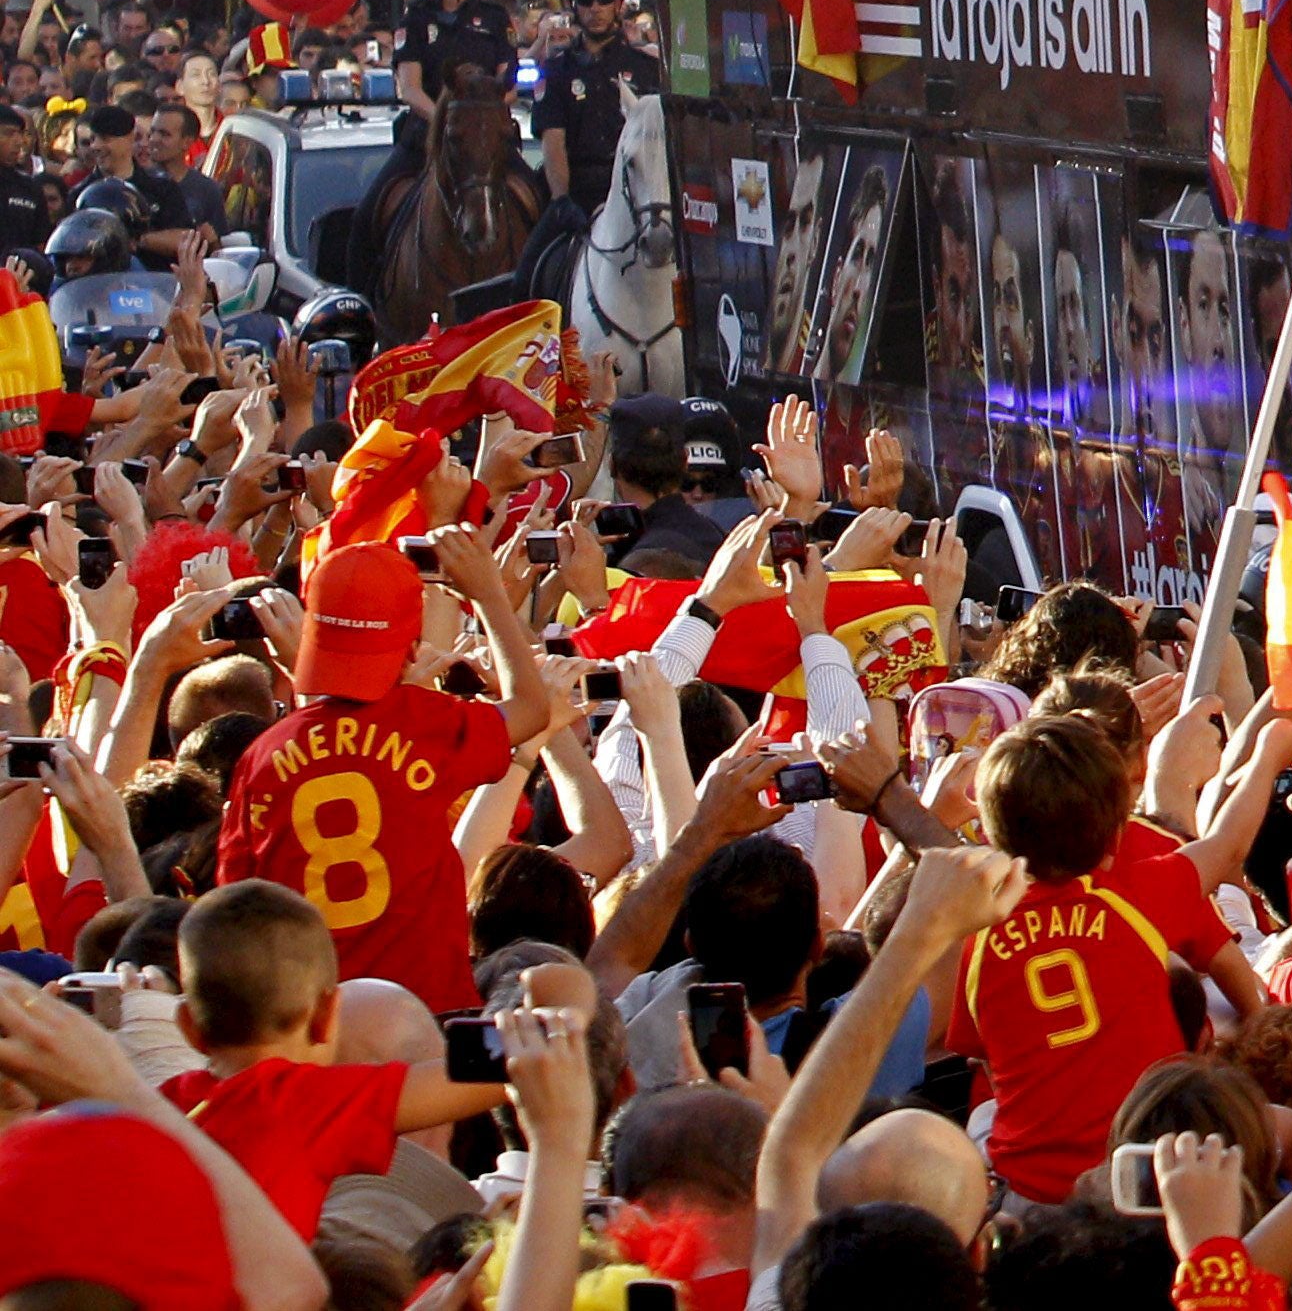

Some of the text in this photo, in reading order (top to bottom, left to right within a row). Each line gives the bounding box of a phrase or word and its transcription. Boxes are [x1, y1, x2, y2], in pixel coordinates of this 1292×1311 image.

[118, 294, 144, 309] tve
[688, 446, 727, 459] LICI
[271, 716, 436, 791] MERINO
[291, 771, 392, 930] 8
[988, 903, 1107, 961] ESPAÑA
[1023, 947, 1101, 1050] 9
